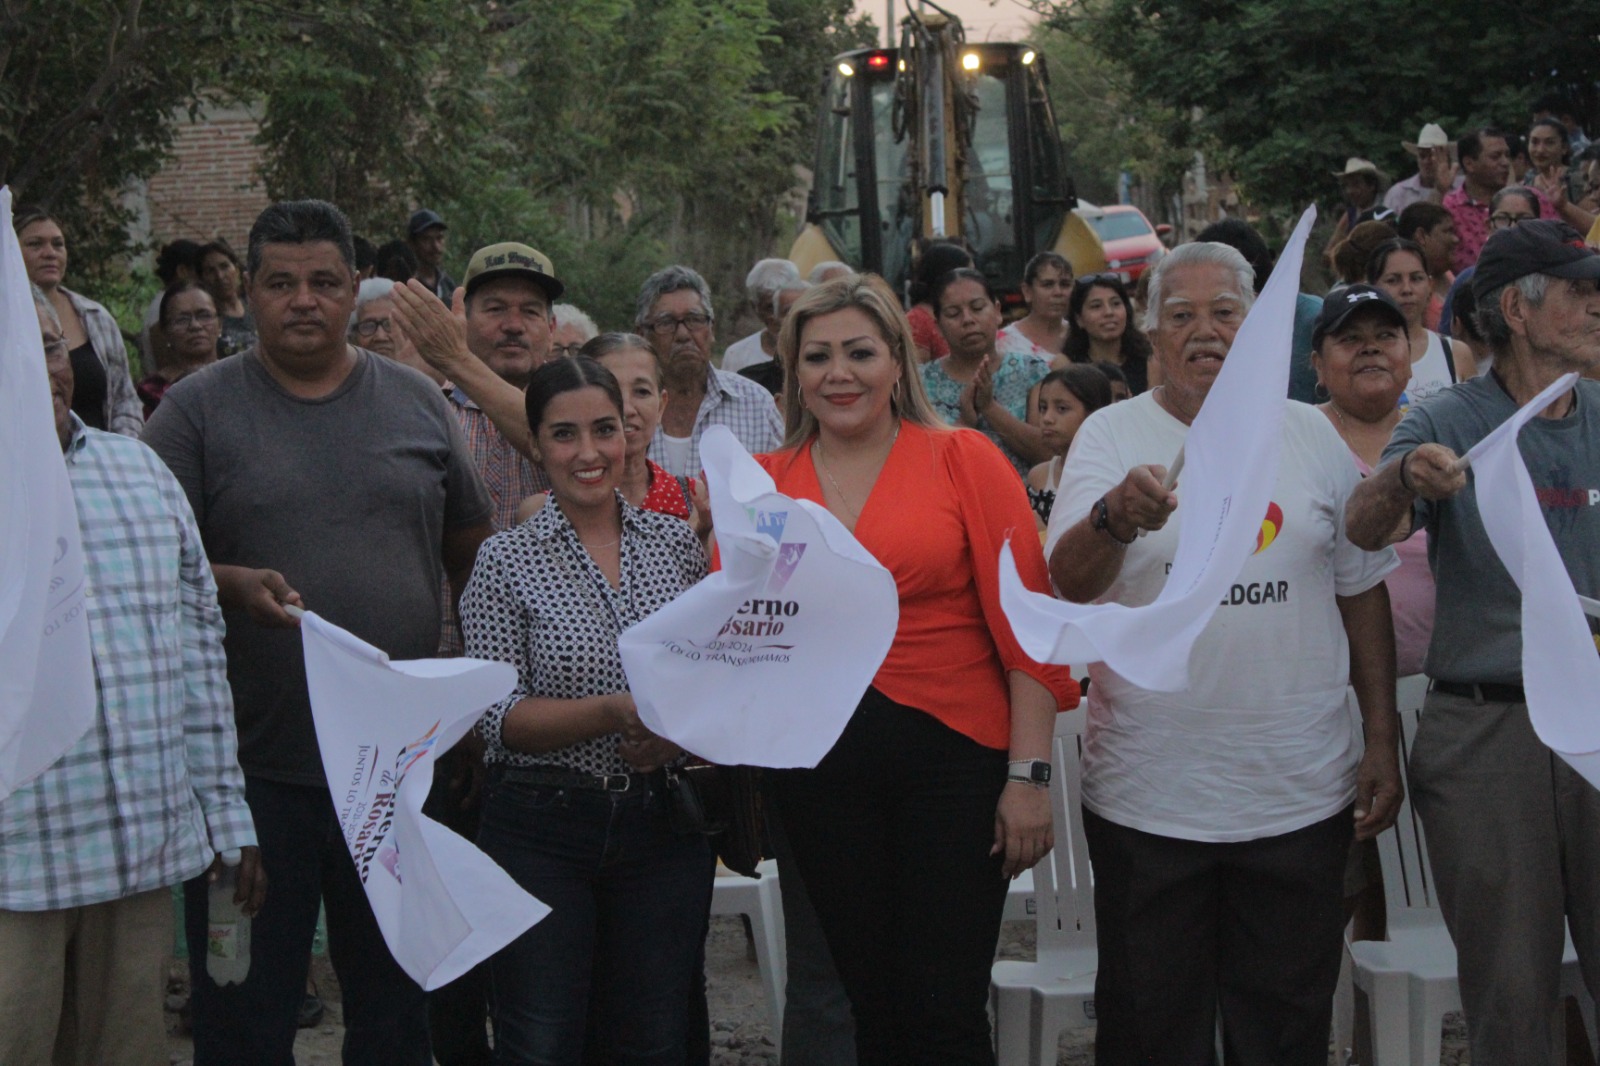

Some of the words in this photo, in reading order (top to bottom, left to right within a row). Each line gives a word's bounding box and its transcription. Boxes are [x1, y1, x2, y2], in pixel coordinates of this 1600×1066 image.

[736, 599, 799, 617] erno
[717, 614, 784, 640] osario
[705, 641, 753, 653] 021-2024
[379, 770, 394, 787] de
[345, 789, 358, 804] LO
[354, 791, 393, 873] Rosari
